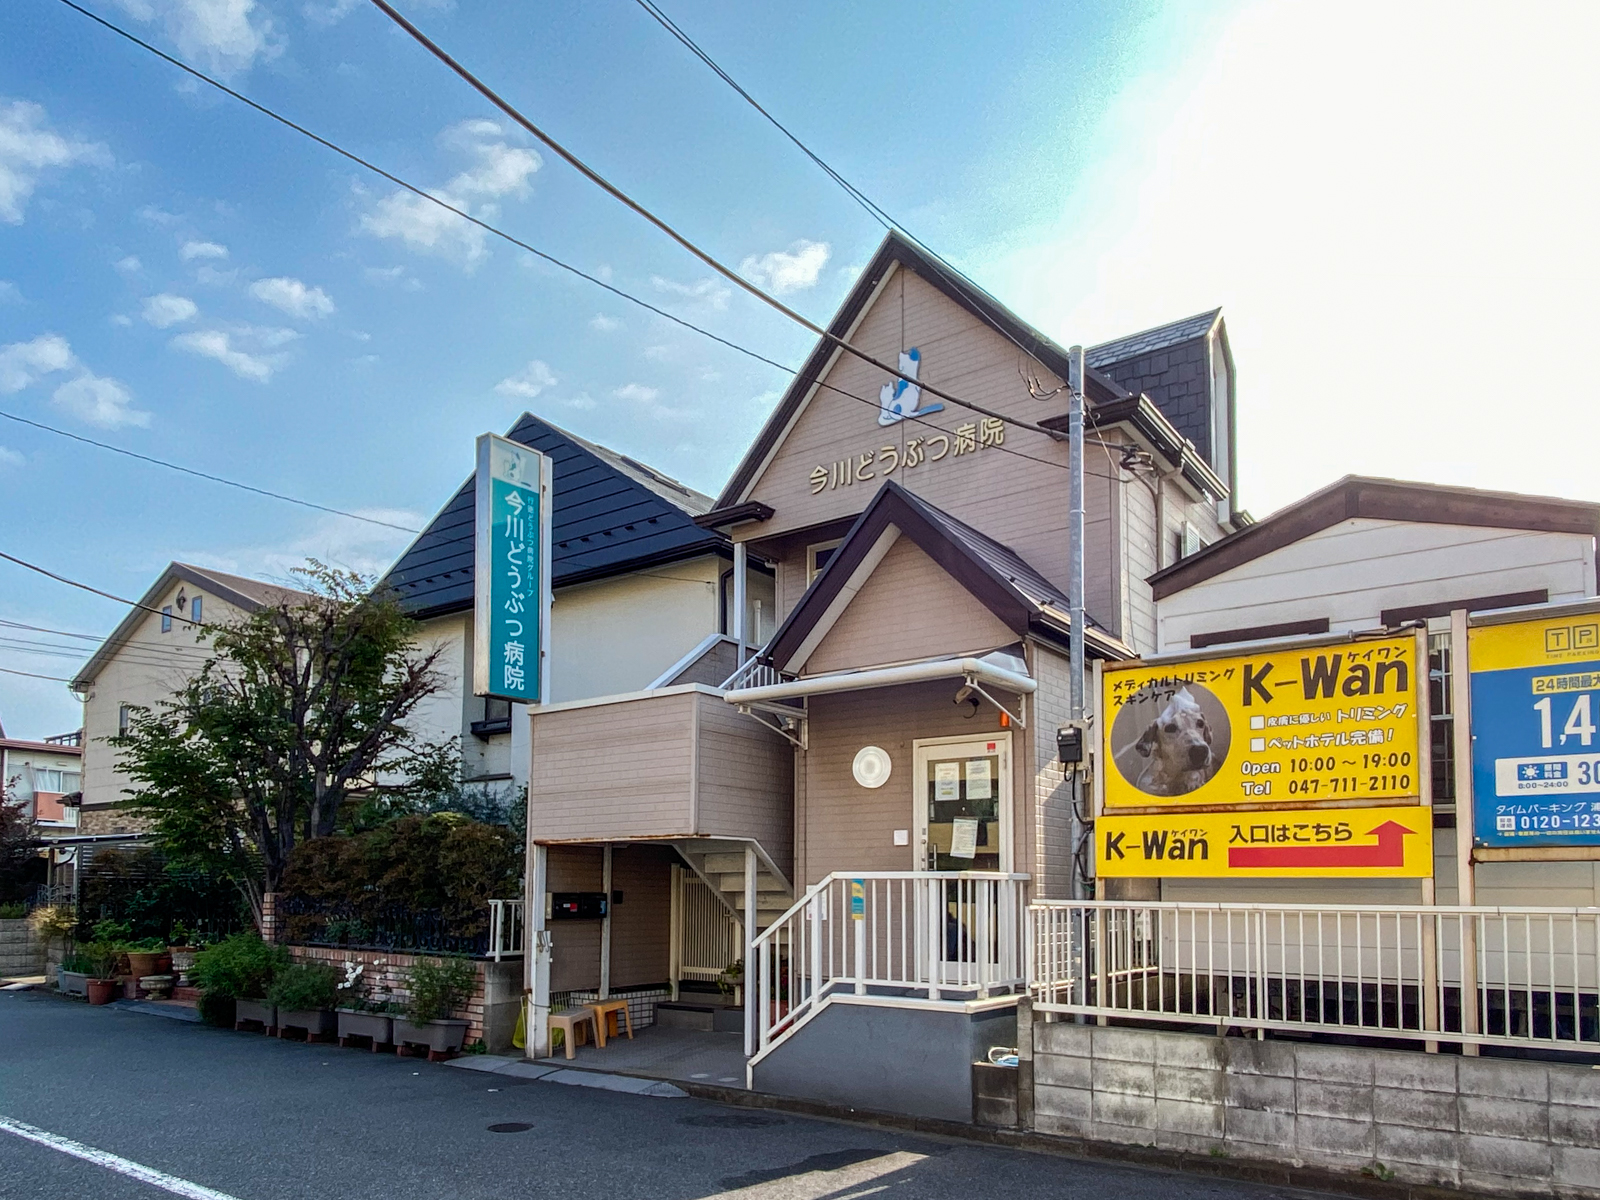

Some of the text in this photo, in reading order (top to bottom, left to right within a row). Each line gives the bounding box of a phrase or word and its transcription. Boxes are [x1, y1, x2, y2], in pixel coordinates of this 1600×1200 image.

[809, 417, 1005, 495] 今川どうぶつ病院
[504, 490, 525, 691] 今川どうぶつ病院
[1346, 646, 1408, 663] ケイワン
[1112, 667, 1236, 693] メディカルトリミング
[1535, 674, 1600, 692] 24時間最大
[1113, 690, 1176, 707] スキンケア
[1267, 703, 1409, 728] 皮膚に優しい トリミング
[1241, 760, 1281, 777] Open
[1289, 757, 1337, 773] 10:00
[1362, 751, 1411, 769] 19:00
[1241, 775, 1411, 796] Tel 047-711-2110
[1495, 802, 1587, 815] タイムパーキング
[1170, 828, 1209, 838] ケイワン
[1228, 822, 1354, 843] 入口はこちら
